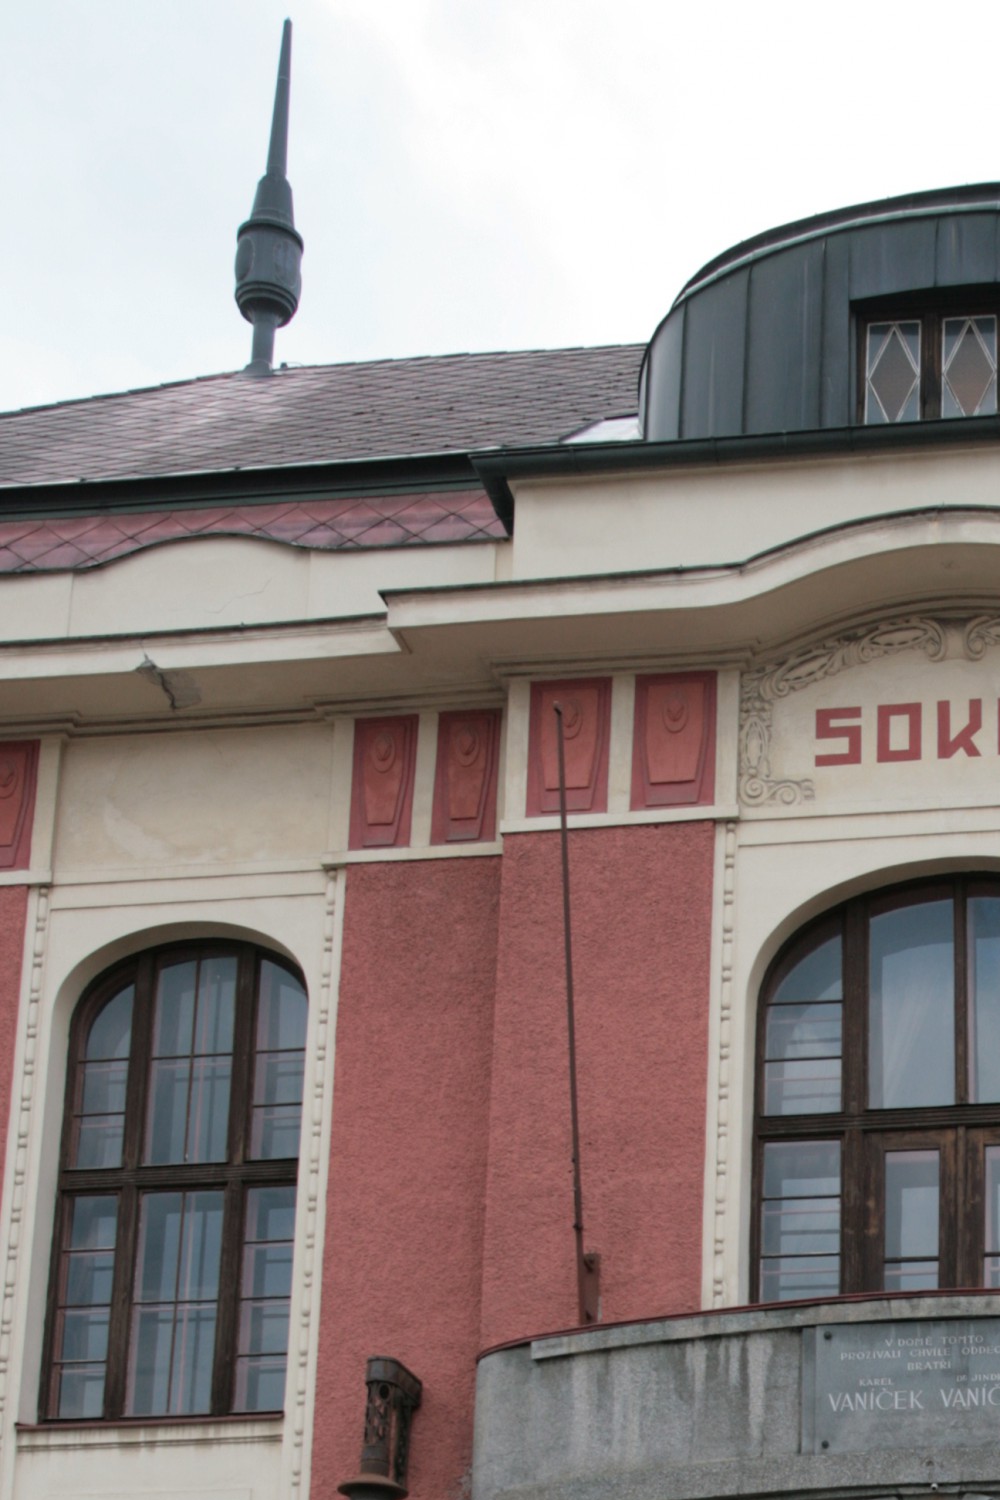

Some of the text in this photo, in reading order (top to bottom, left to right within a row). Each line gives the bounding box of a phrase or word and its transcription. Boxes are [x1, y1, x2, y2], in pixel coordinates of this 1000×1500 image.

[884, 1338, 894, 1347] V
[941, 1335, 984, 1345] TOMTO
[858, 1377, 895, 1387] KAREL
[828, 1387, 925, 1412] VANÍČEK
